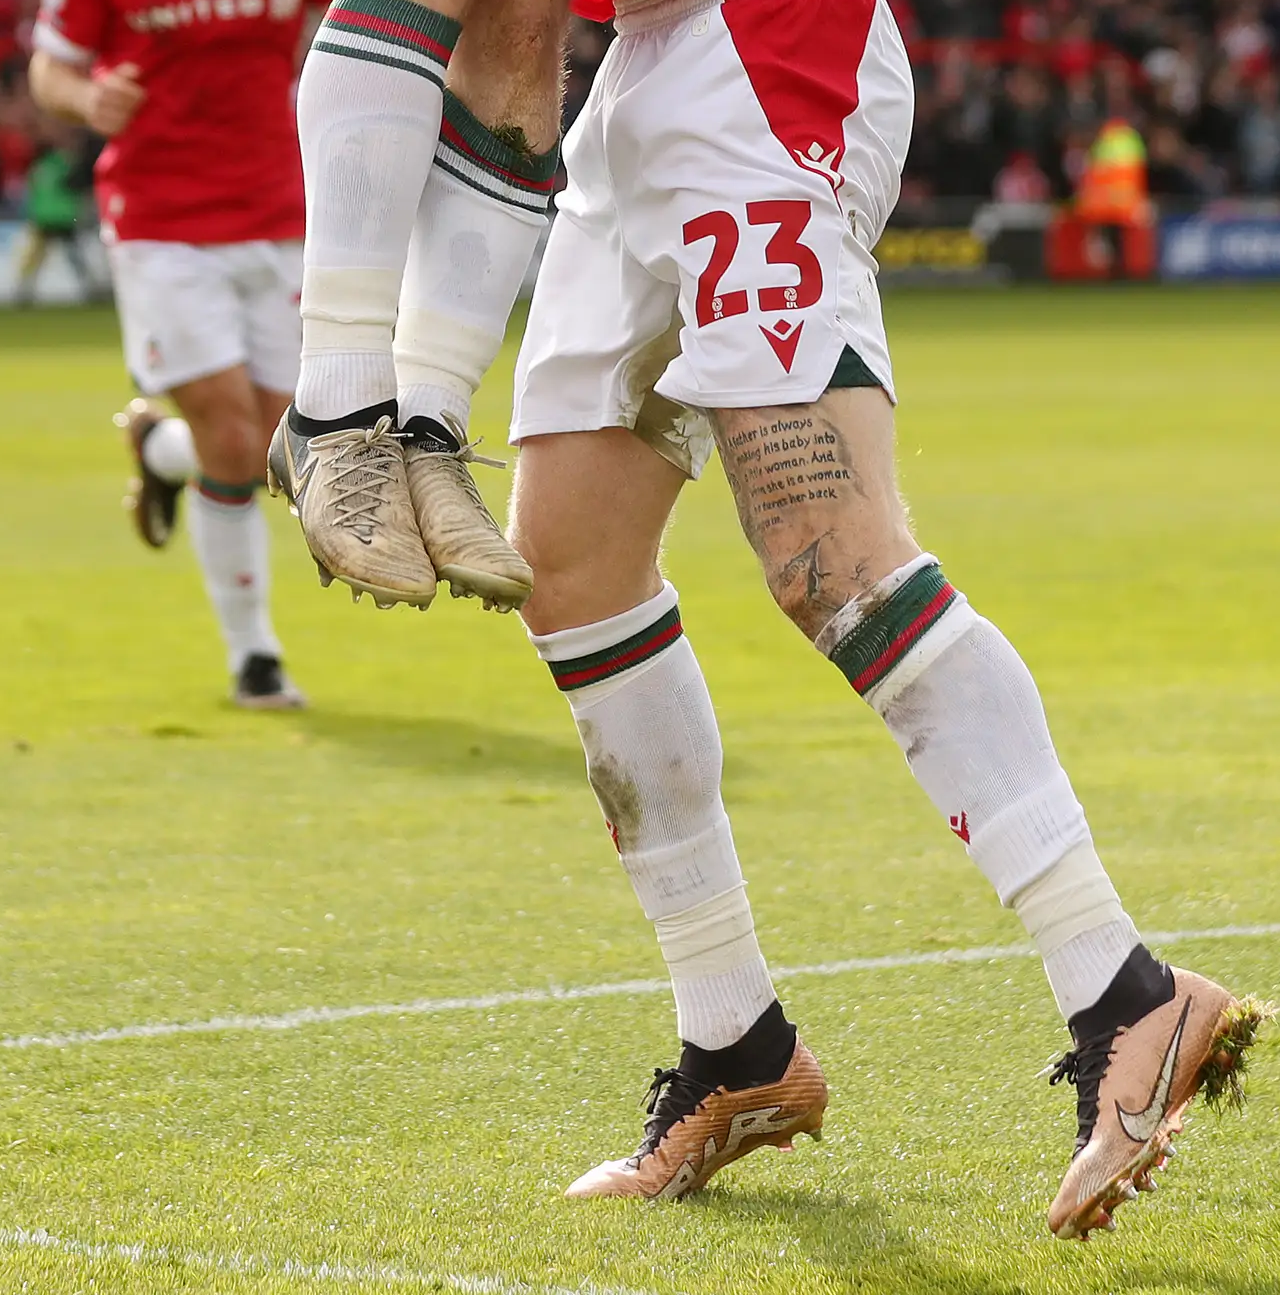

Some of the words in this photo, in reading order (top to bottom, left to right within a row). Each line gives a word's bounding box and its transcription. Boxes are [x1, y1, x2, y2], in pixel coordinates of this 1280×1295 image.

[682, 199, 824, 328] 23
[771, 418, 813, 433] always
[763, 442, 780, 456] his
[782, 435, 811, 452] baby
[814, 431, 836, 445] into
[811, 450, 836, 463] And
[767, 479, 785, 493] she
[807, 469, 850, 483] woman
[789, 492, 807, 504] her
[808, 486, 838, 500] back
